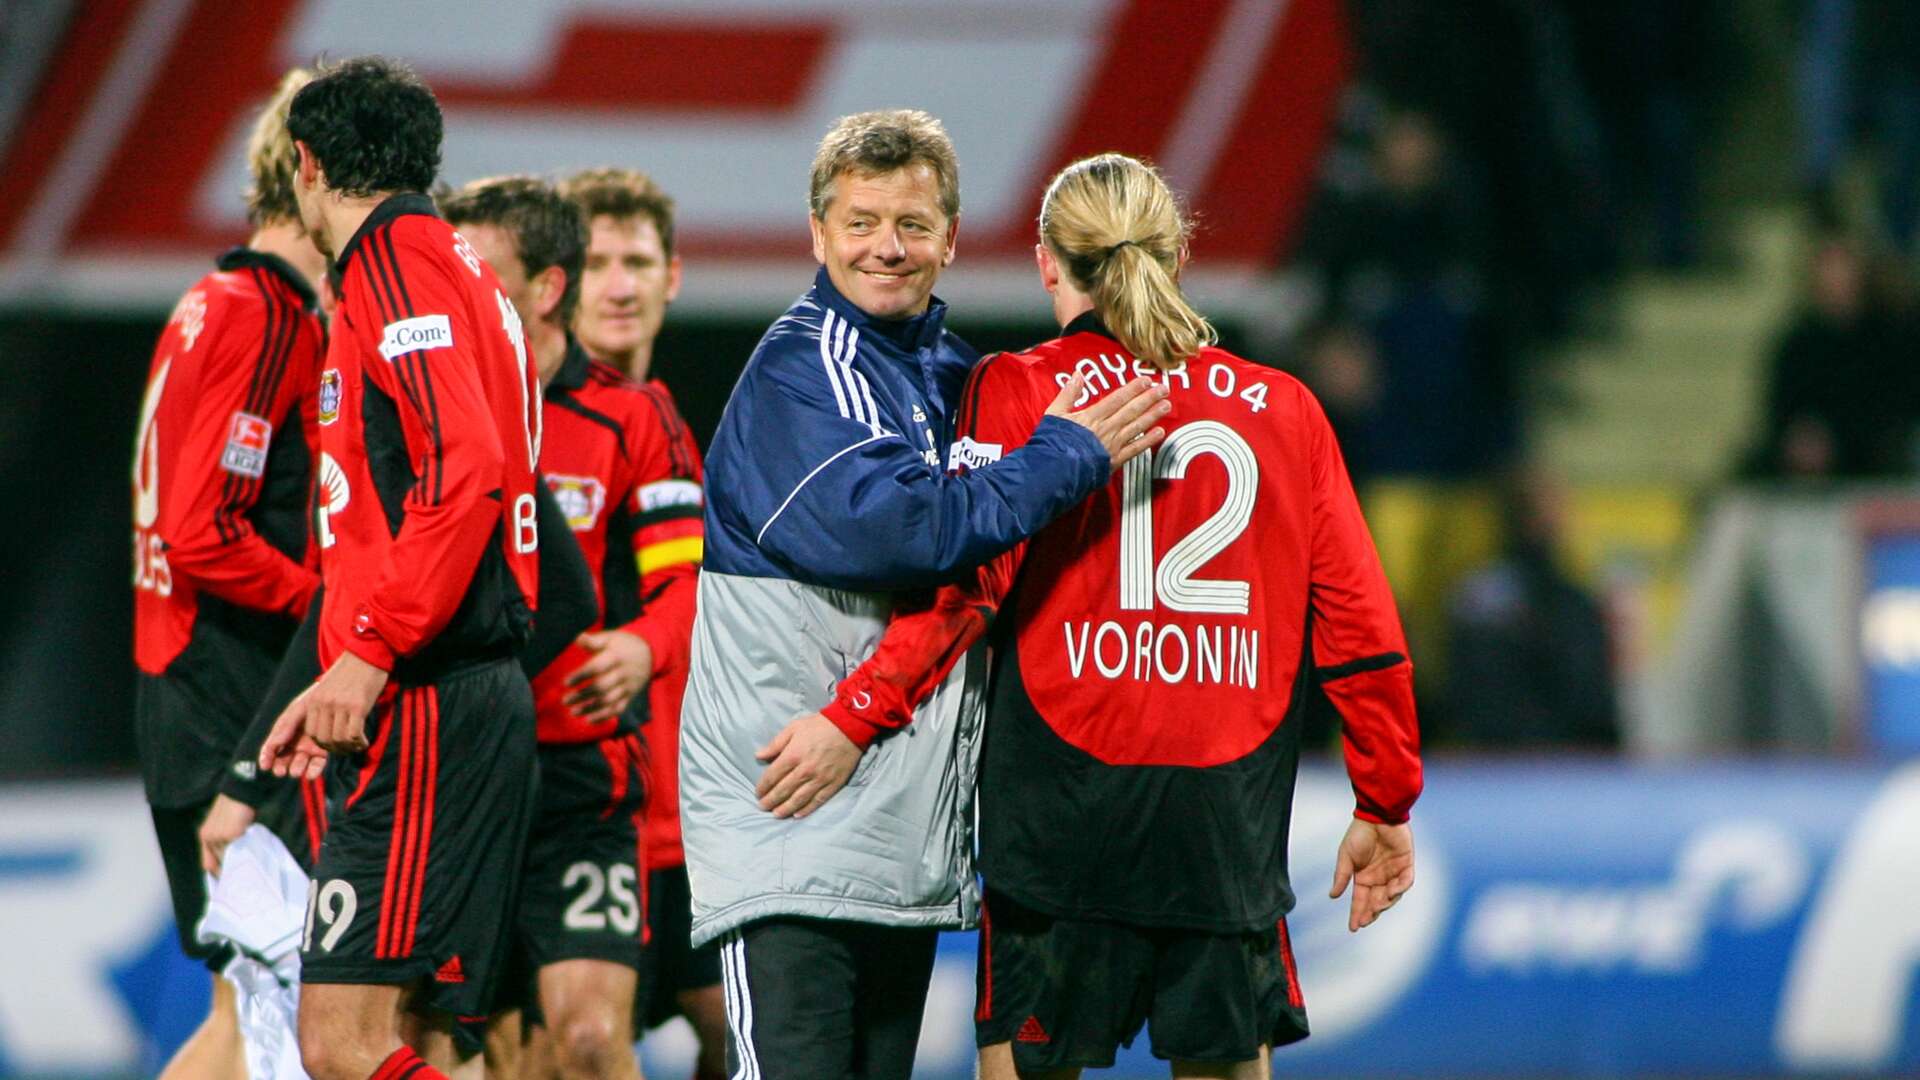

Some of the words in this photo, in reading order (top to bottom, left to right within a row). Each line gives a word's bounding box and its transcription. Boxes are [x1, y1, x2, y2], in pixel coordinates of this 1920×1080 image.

[1207, 363, 1270, 413] 04
[1119, 419, 1260, 615] 12
[1064, 620, 1259, 690] VORONIN
[302, 878, 358, 953] 19
[562, 861, 640, 935] 25
